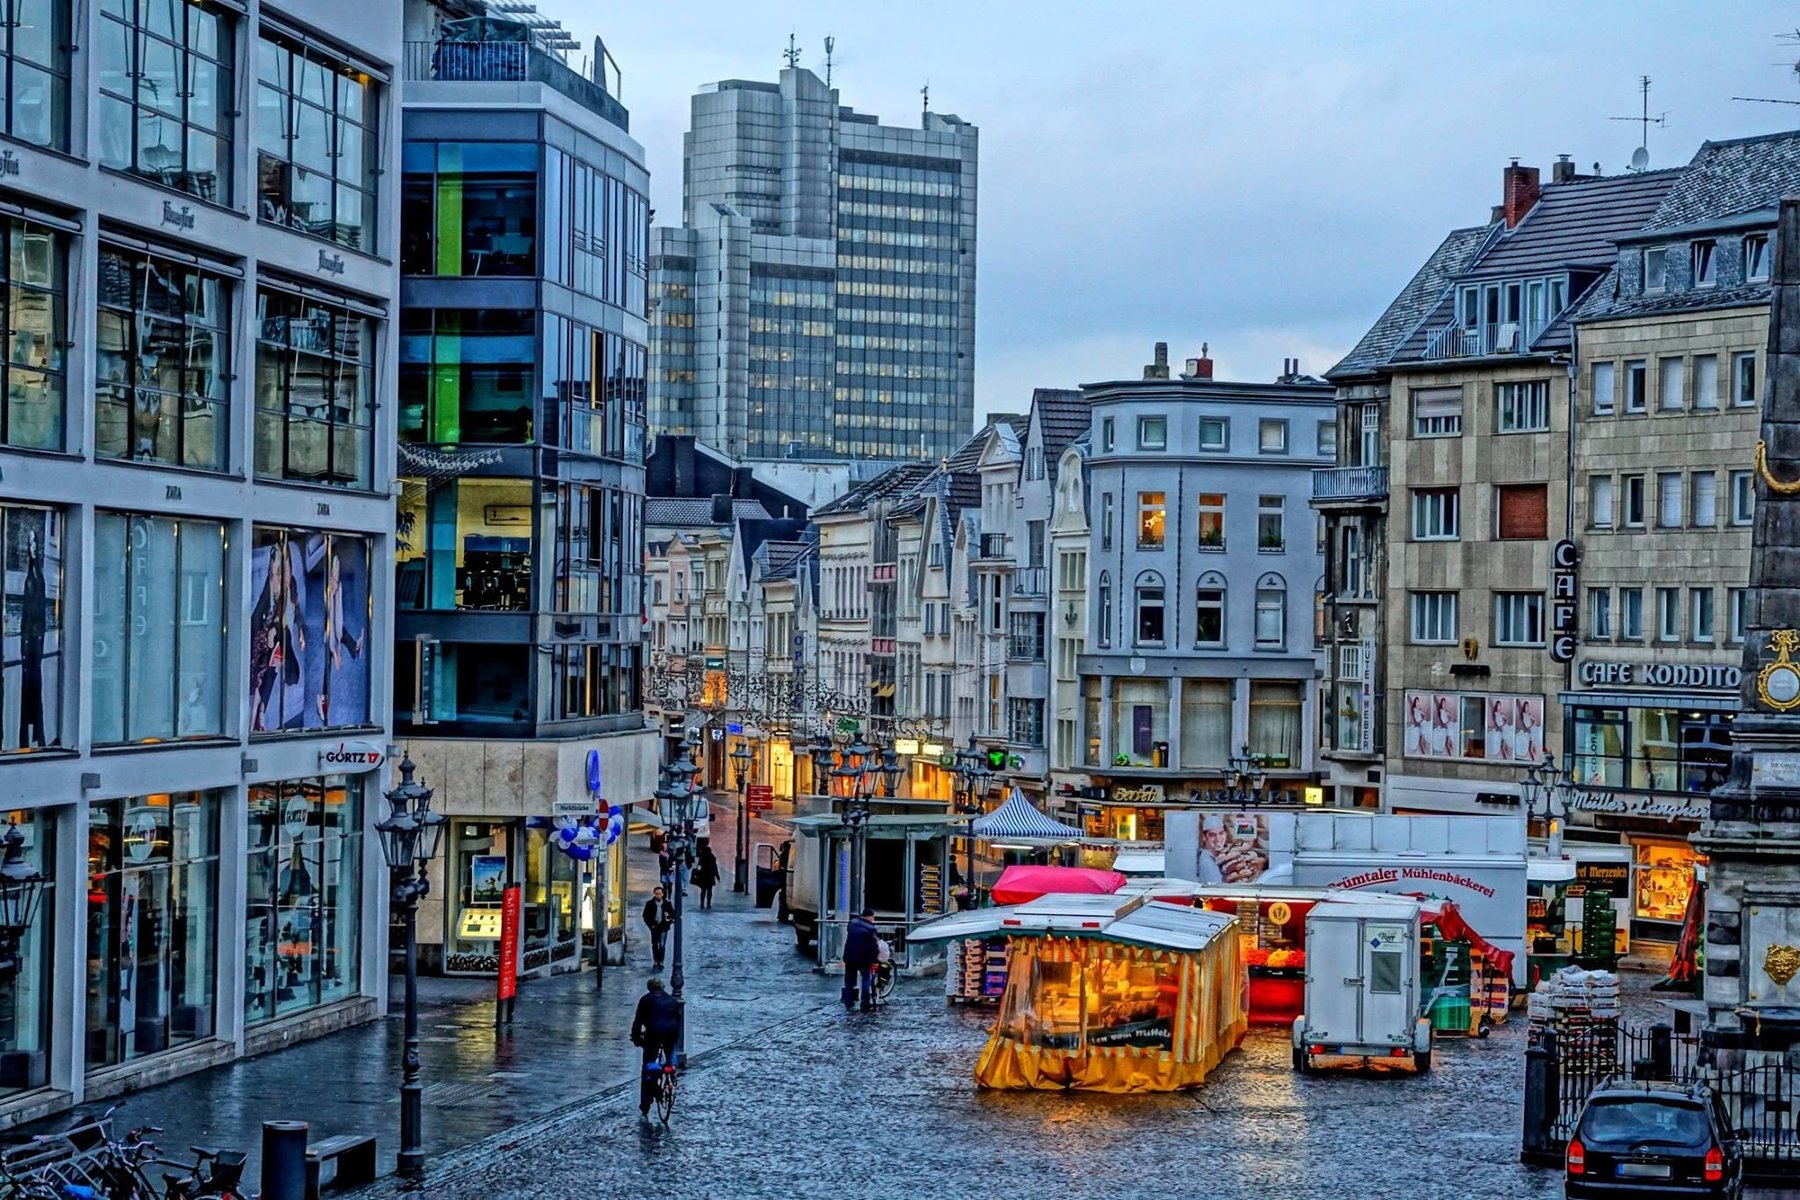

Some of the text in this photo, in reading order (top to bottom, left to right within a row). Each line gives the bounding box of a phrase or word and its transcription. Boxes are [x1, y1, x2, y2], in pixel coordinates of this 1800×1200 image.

[1556, 543, 1574, 659] CAFE
[1581, 661, 1743, 688] CAFE KONDITO
[367, 752, 380, 764] 17
[1572, 788, 1709, 823] Müller Langhar
[1402, 868, 1496, 898] Mühlenbäckerei
